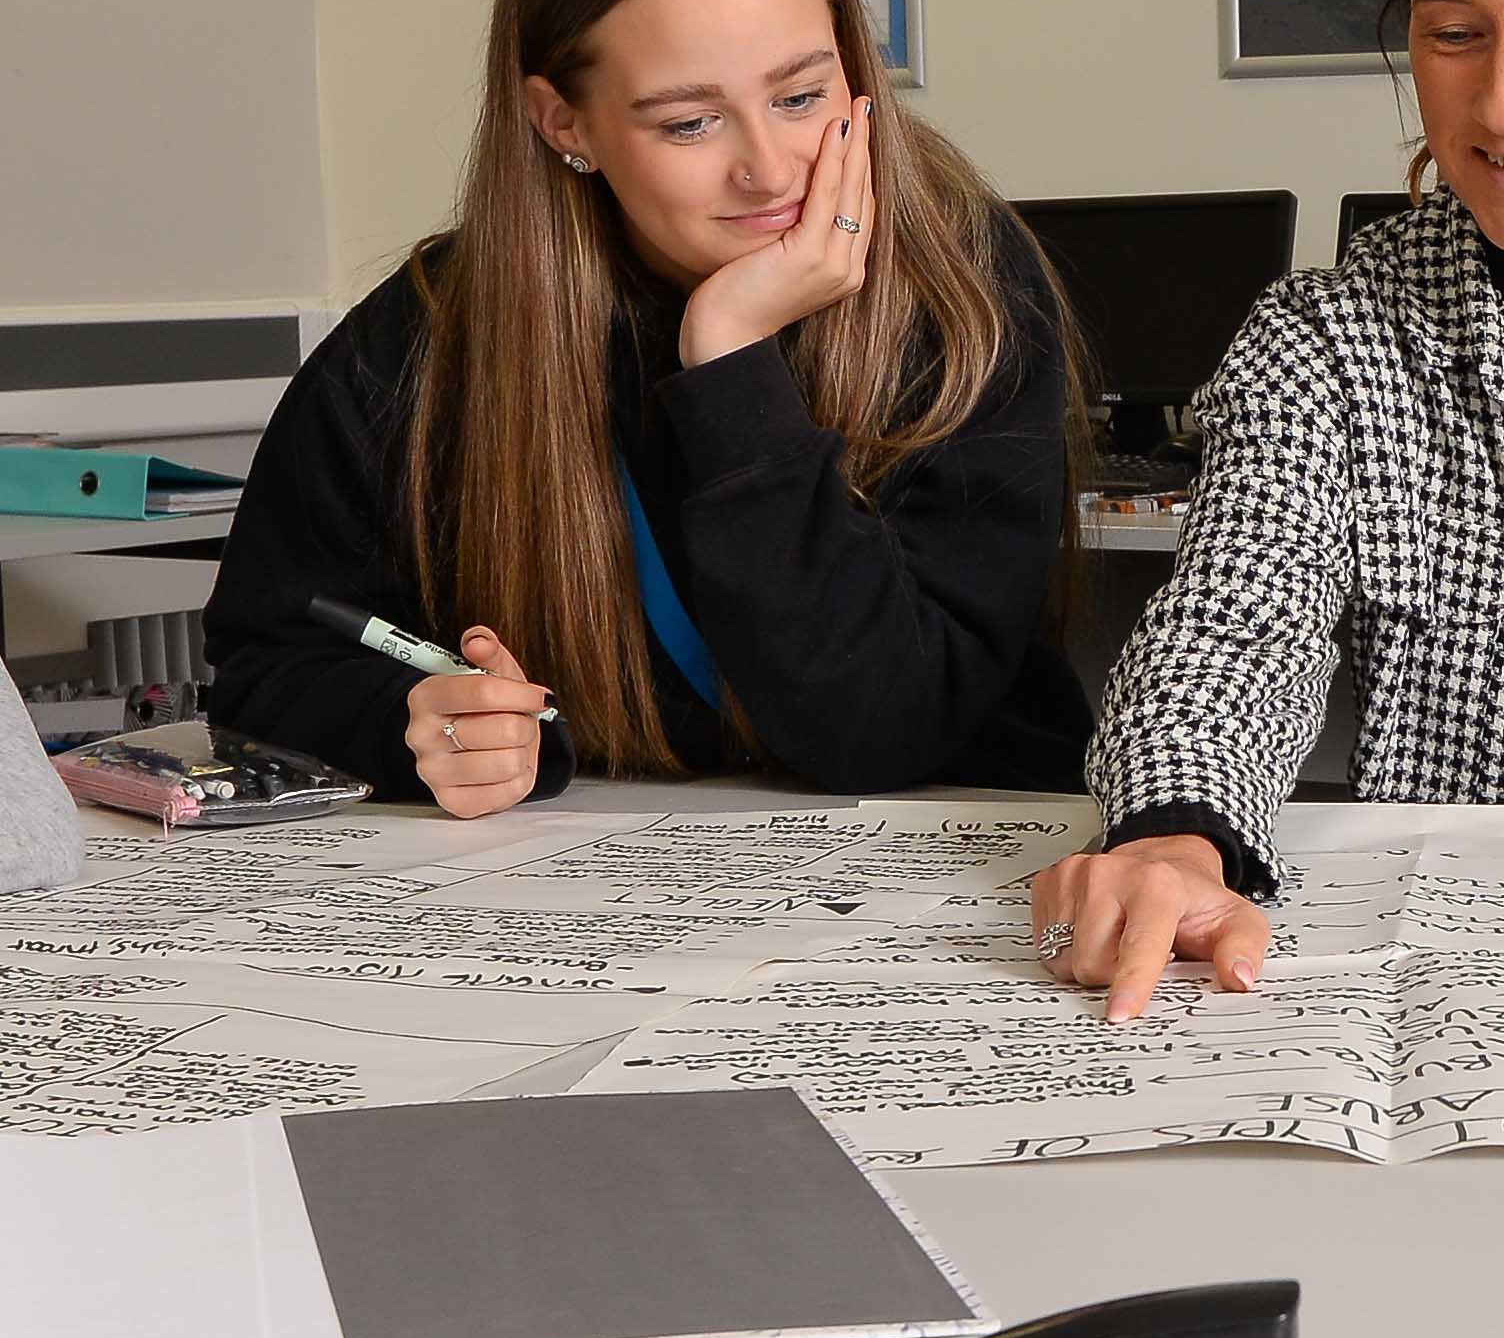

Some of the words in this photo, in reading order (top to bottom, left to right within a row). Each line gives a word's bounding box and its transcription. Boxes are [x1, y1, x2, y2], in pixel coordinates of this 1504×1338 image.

[604, 892, 814, 913] NEGLECT
[1256, 1091, 1493, 1126] ABUSE
[980, 1137, 1090, 1161] OF
[1153, 1119, 1386, 1161] TYPES
